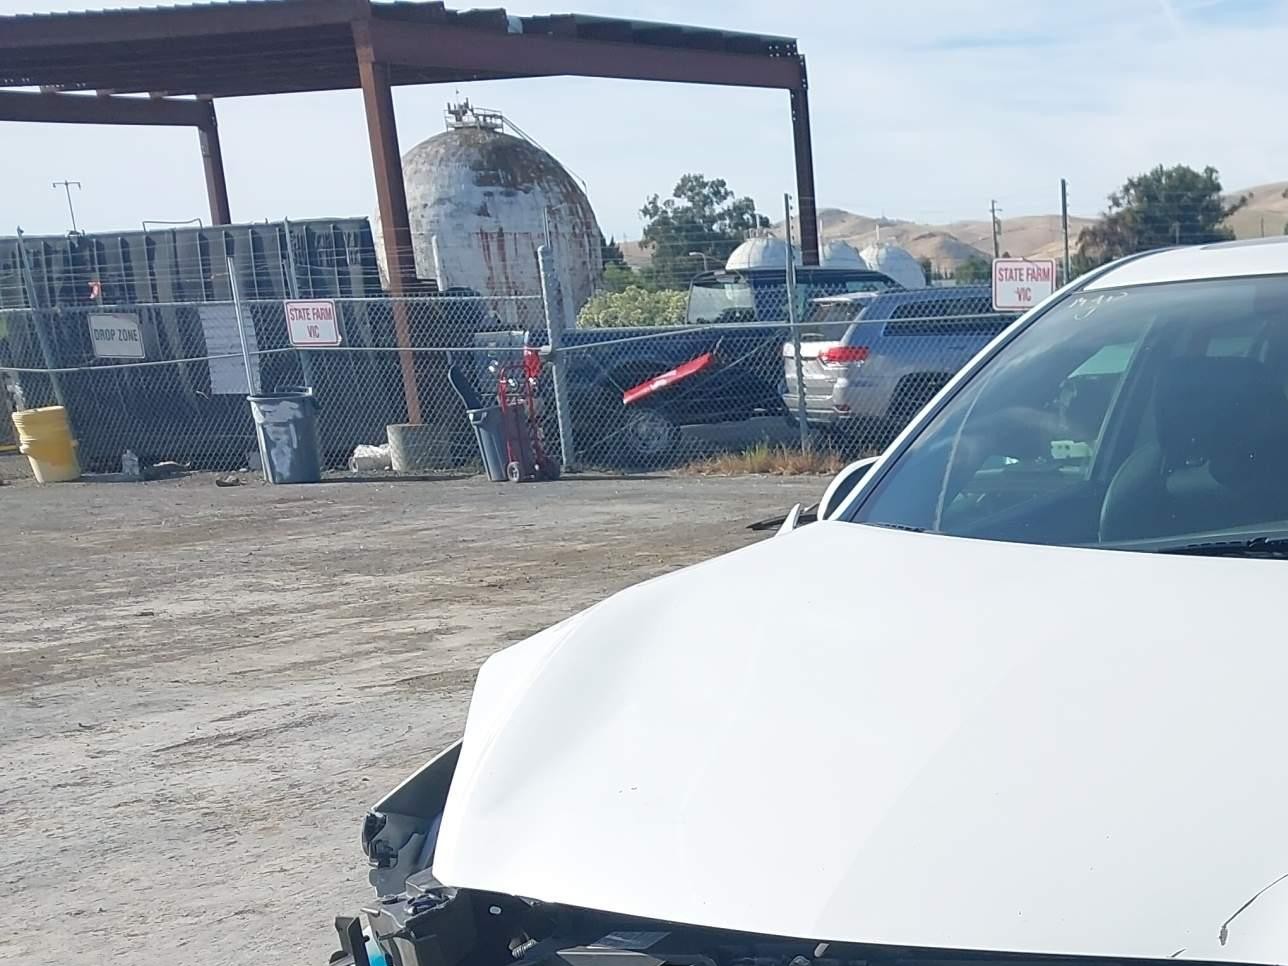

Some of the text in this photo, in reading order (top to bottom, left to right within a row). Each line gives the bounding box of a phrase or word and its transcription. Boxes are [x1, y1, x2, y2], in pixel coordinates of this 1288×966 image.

[998, 266, 1050, 282] STATE FARM
[1016, 287, 1032, 302] VIC
[290, 307, 333, 320] STATE FARM
[94, 328, 139, 341] DROP ZONE
[306, 325, 320, 338] VIC
